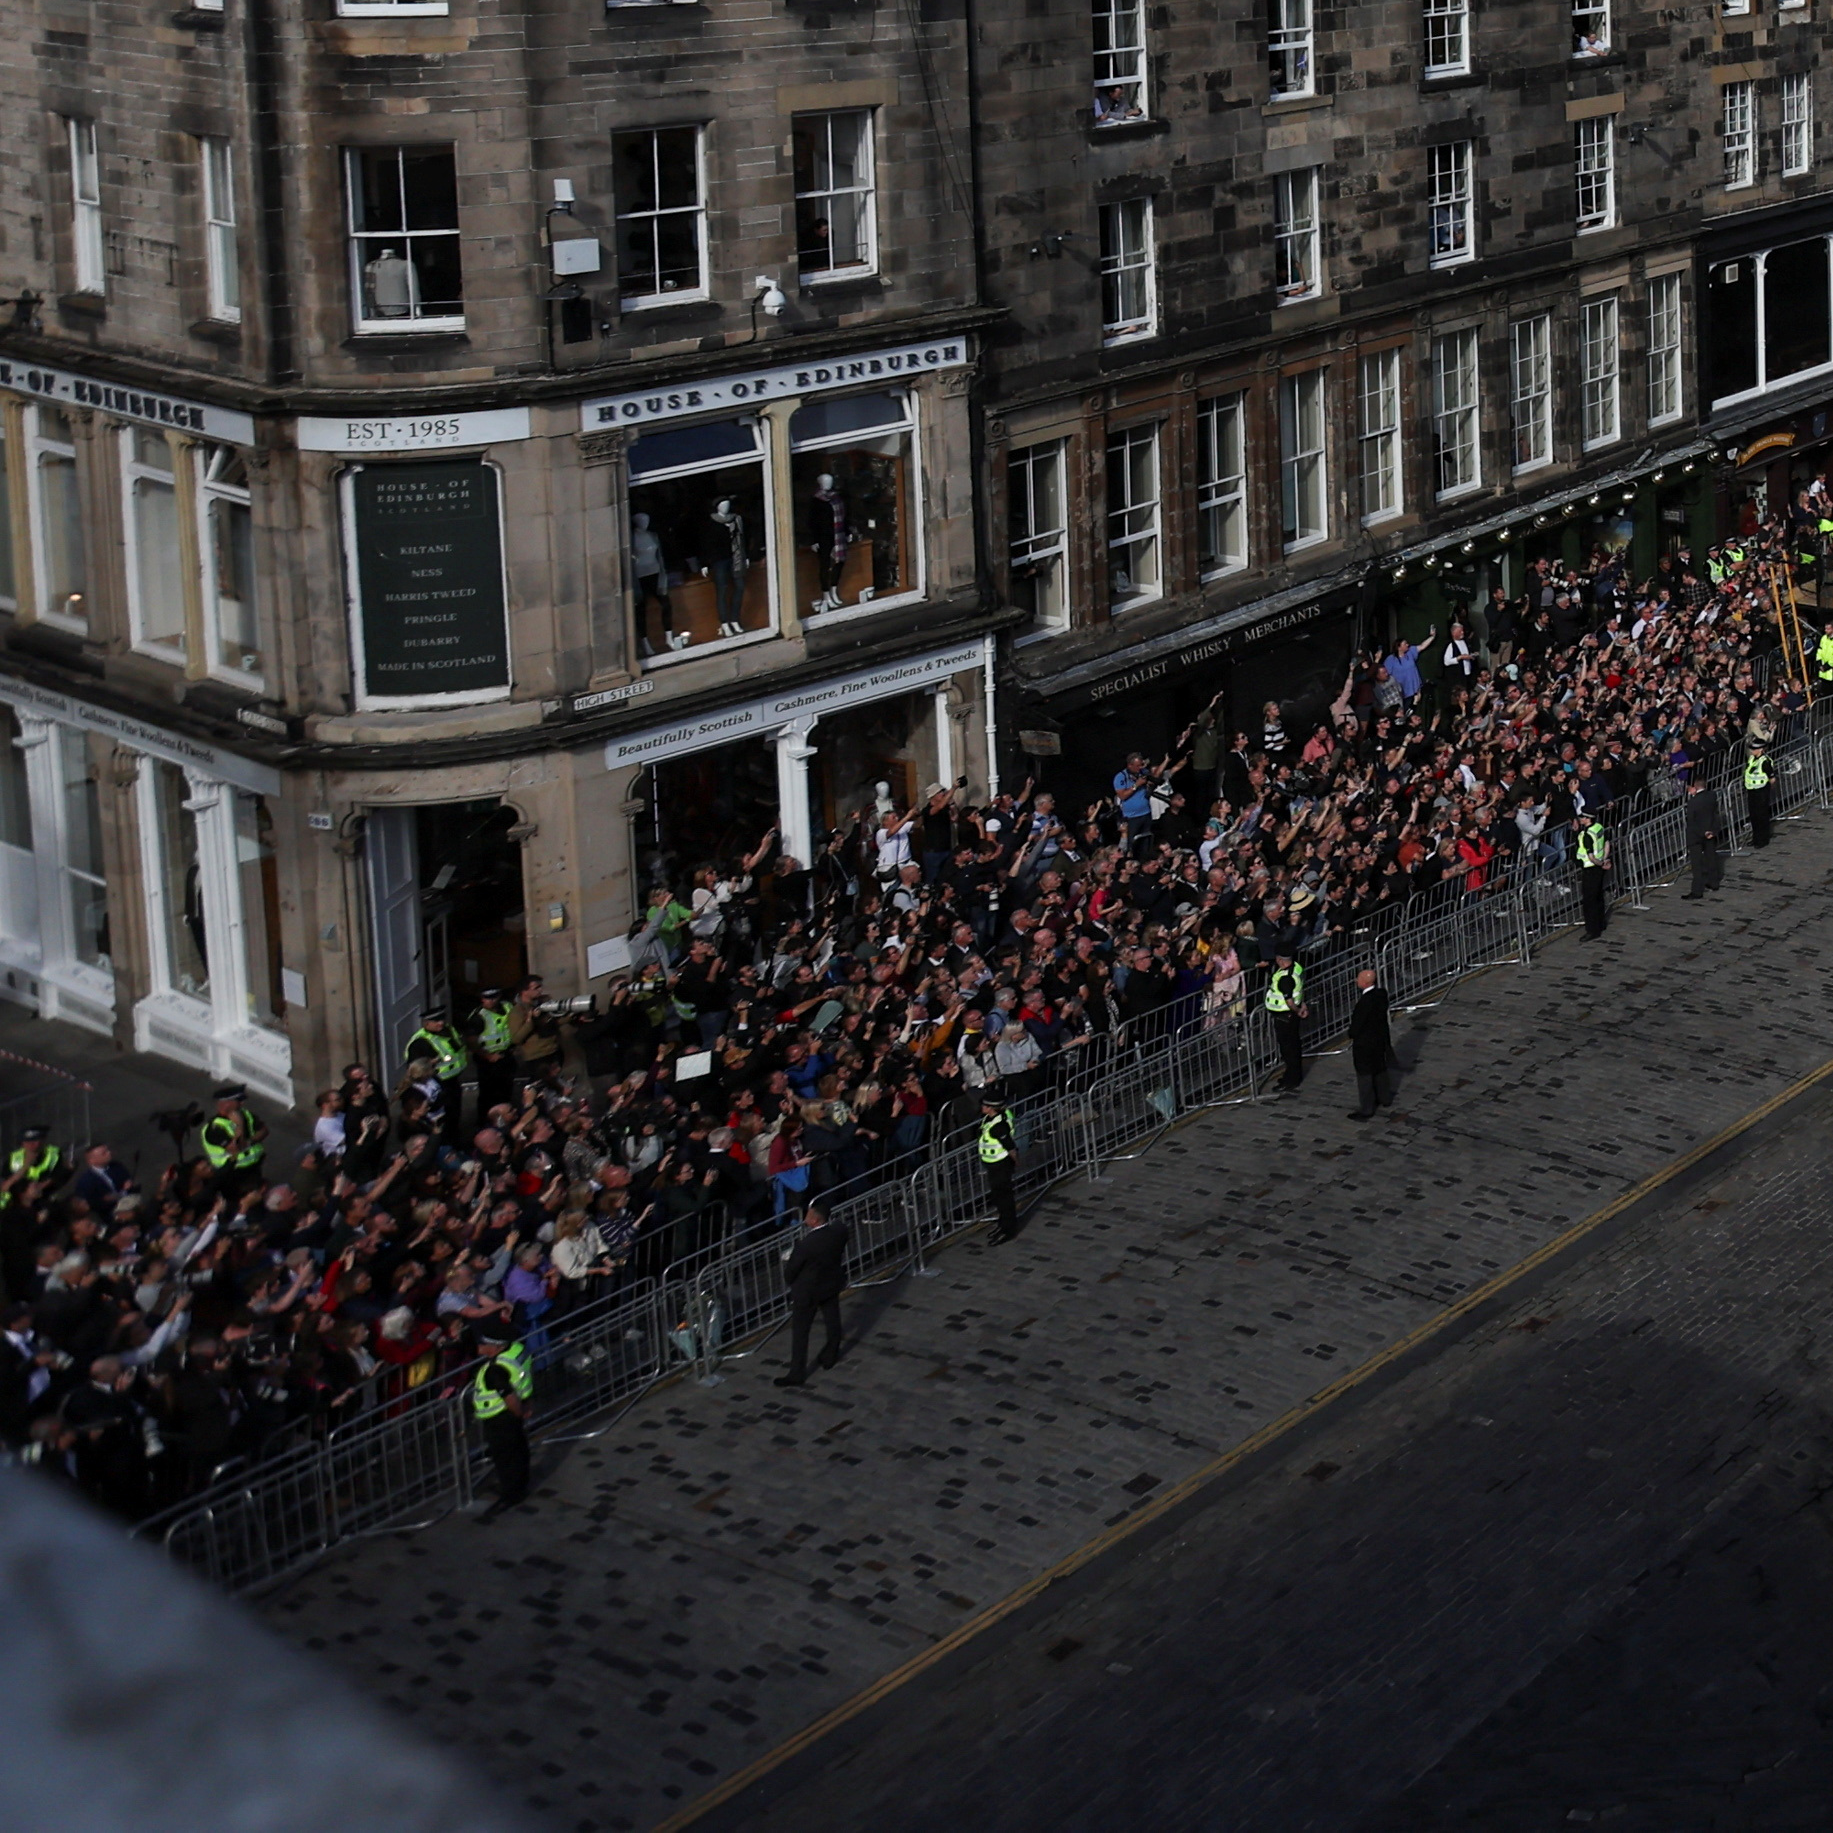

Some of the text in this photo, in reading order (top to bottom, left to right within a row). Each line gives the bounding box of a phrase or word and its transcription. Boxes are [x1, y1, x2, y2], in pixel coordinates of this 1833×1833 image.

[597, 345, 960, 423] HOUSE OF EDINBURGH
[74, 379, 206, 431] EDINBURGH
[346, 418, 461, 440] EST 1985
[347, 436, 460, 447] SCOTLAND
[377, 479, 470, 492] HOUSE OF
[376, 490, 470, 503] EDINBURGH
[400, 543, 453, 555] KILTANE
[411, 568, 443, 578] NESS
[385, 588, 477, 602] HARRIS TWEED
[404, 612, 458, 625] PRINGLE
[404, 636, 461, 648] DUBARRY
[1090, 603, 1322, 702] SPECIALIST WHISKY MERCHANTS
[377, 654, 497, 671] MADE IN SCOTLAND
[774, 648, 977, 714] Cashmere, Fine Woollens & Tweeds
[575, 680, 654, 709] HIGH STREET
[617, 710, 753, 759] Beautifully Scottish
